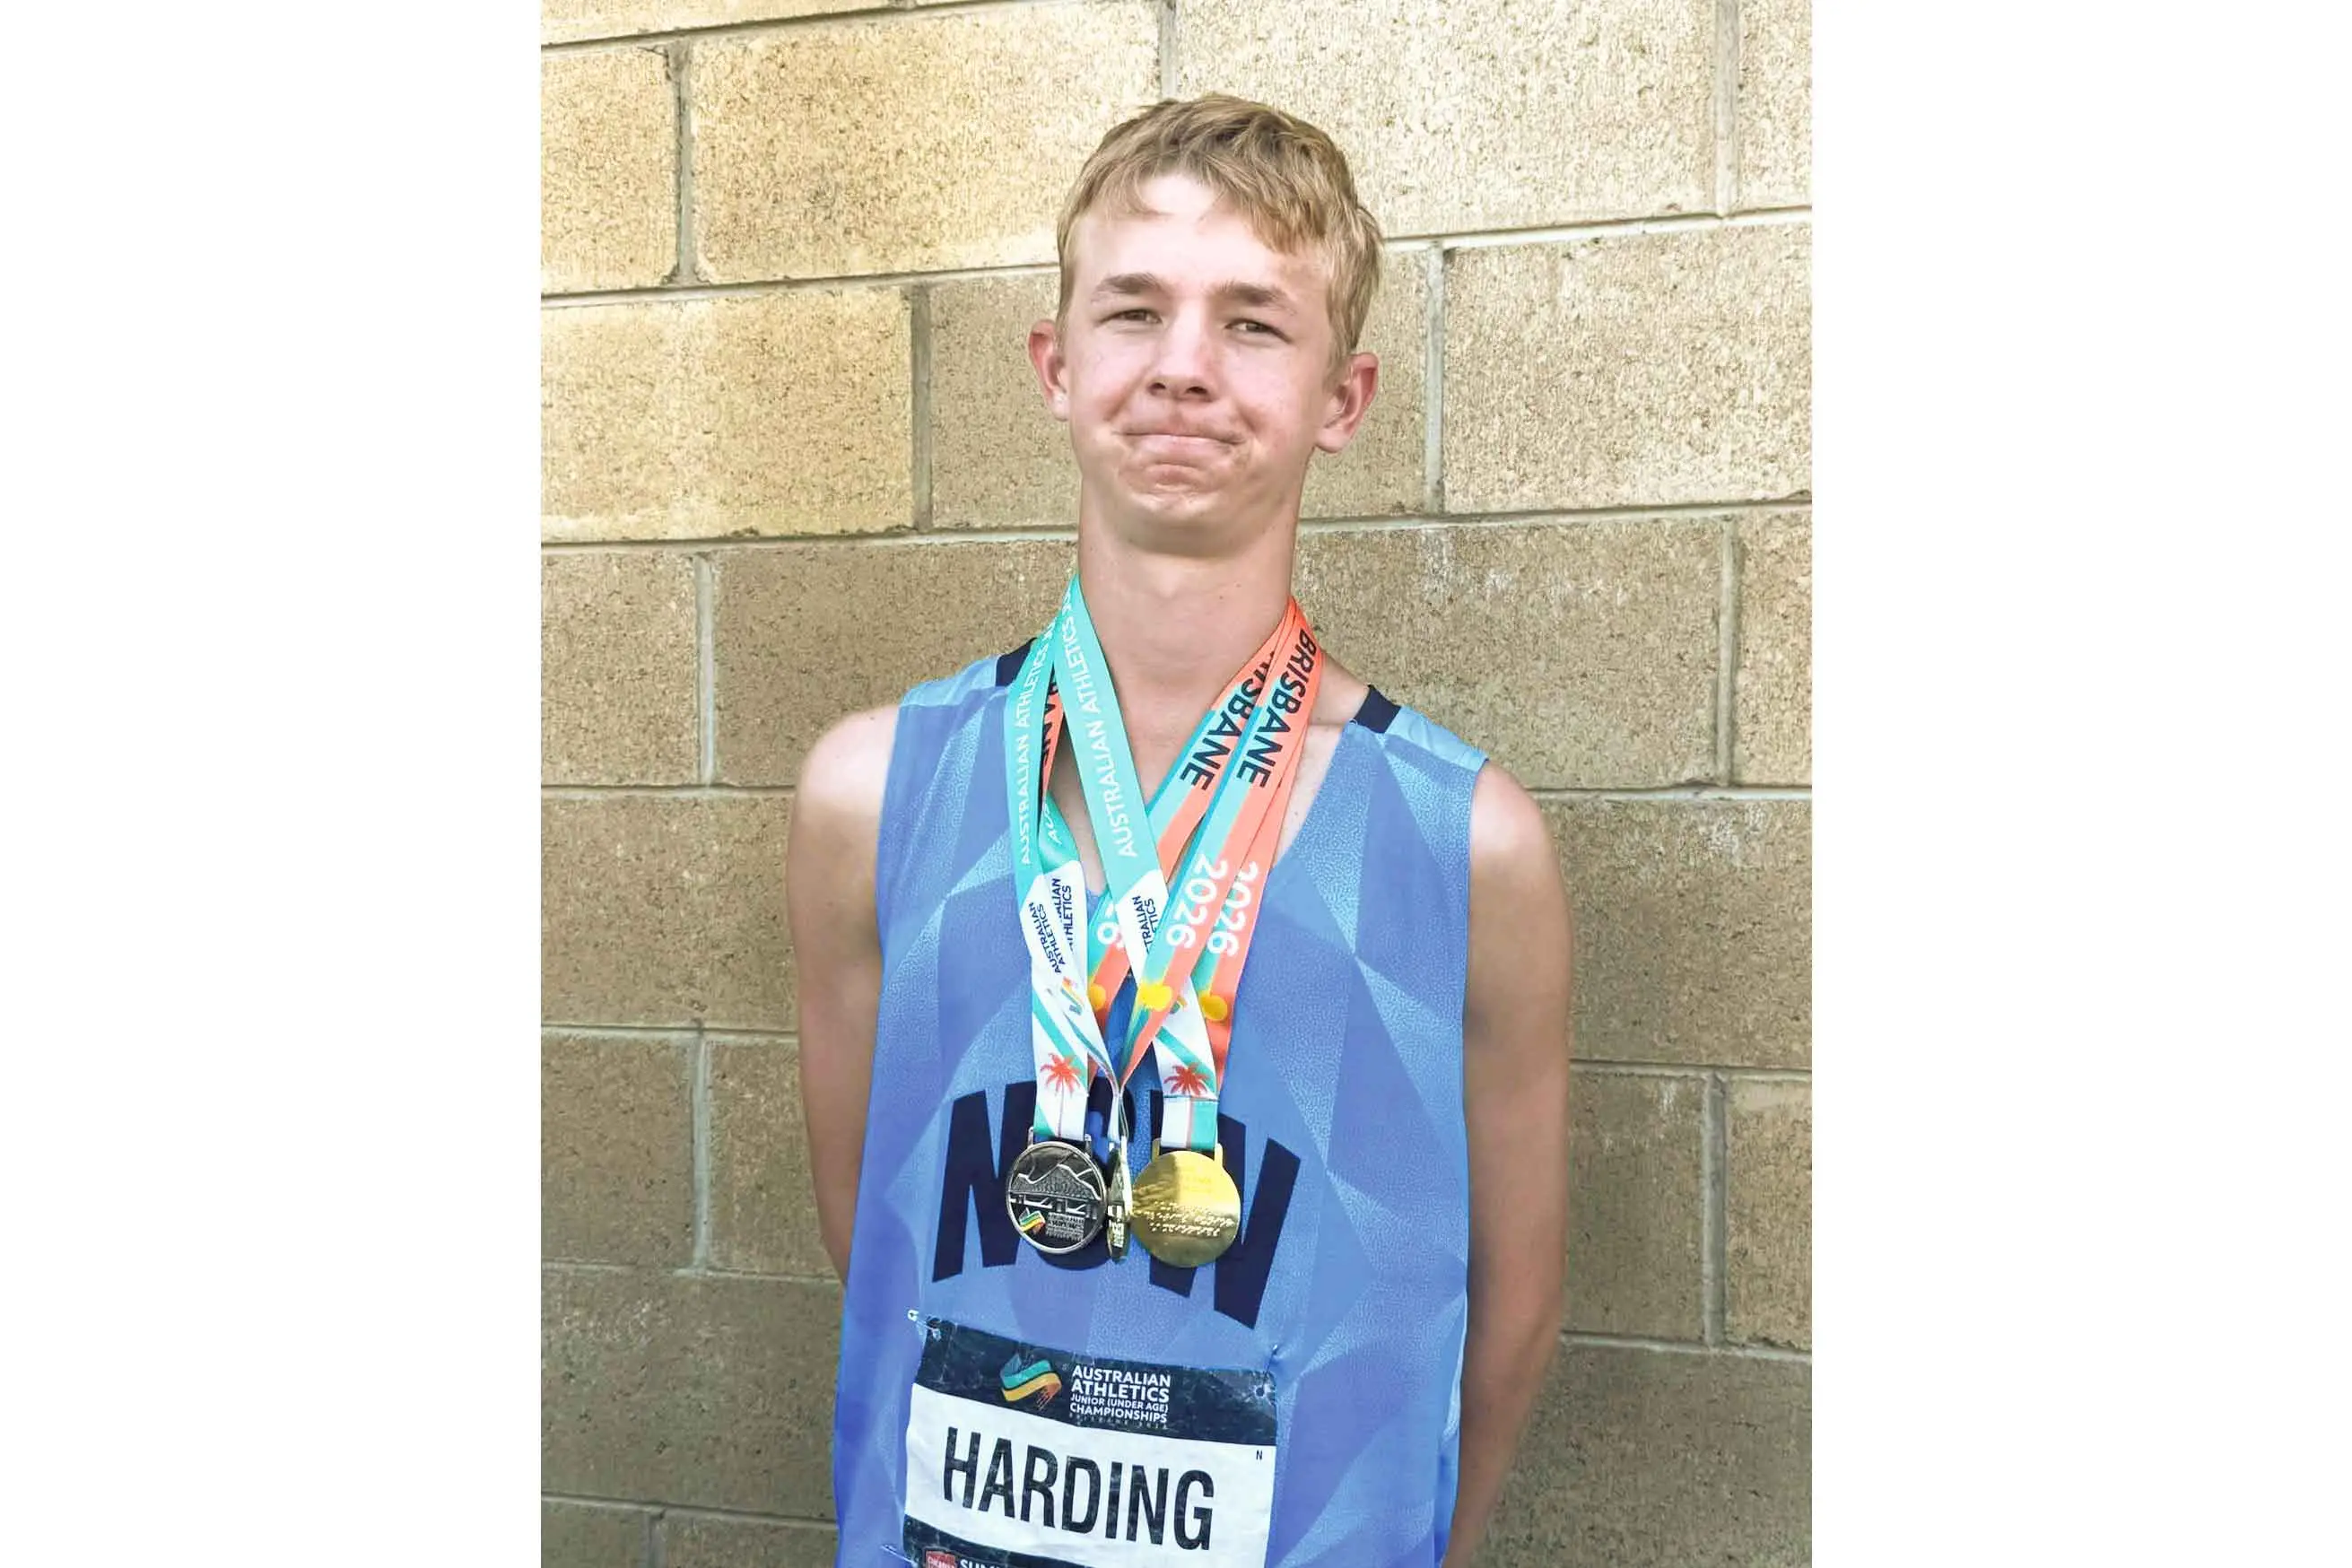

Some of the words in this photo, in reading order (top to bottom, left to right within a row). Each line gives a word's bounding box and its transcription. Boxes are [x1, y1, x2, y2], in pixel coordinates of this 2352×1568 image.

[1061, 615, 1101, 714] ATHLETICS
[1237, 629, 1317, 788] BRISBANE
[1180, 650, 1275, 790] ISBANE
[1017, 733, 1031, 864] AUSTRALIAN
[1085, 718, 1137, 858] AUSTRALIAN
[1037, 903, 1066, 965] ATHLETICS
[1132, 895, 1153, 954] TRALIAN
[1166, 853, 1229, 949] 2026
[1070, 1393, 1105, 1407] JUNIOR
[1107, 1398, 1144, 1410] (UNDER
[1146, 1403, 1169, 1414] AGE)
[1070, 1402, 1168, 1424] CHAMPIONSHIPS
[1071, 1379, 1170, 1403] ATHLETICS
[1072, 1364, 1171, 1388] AUSTRALIAN
[943, 1426, 1215, 1551] HARDING
